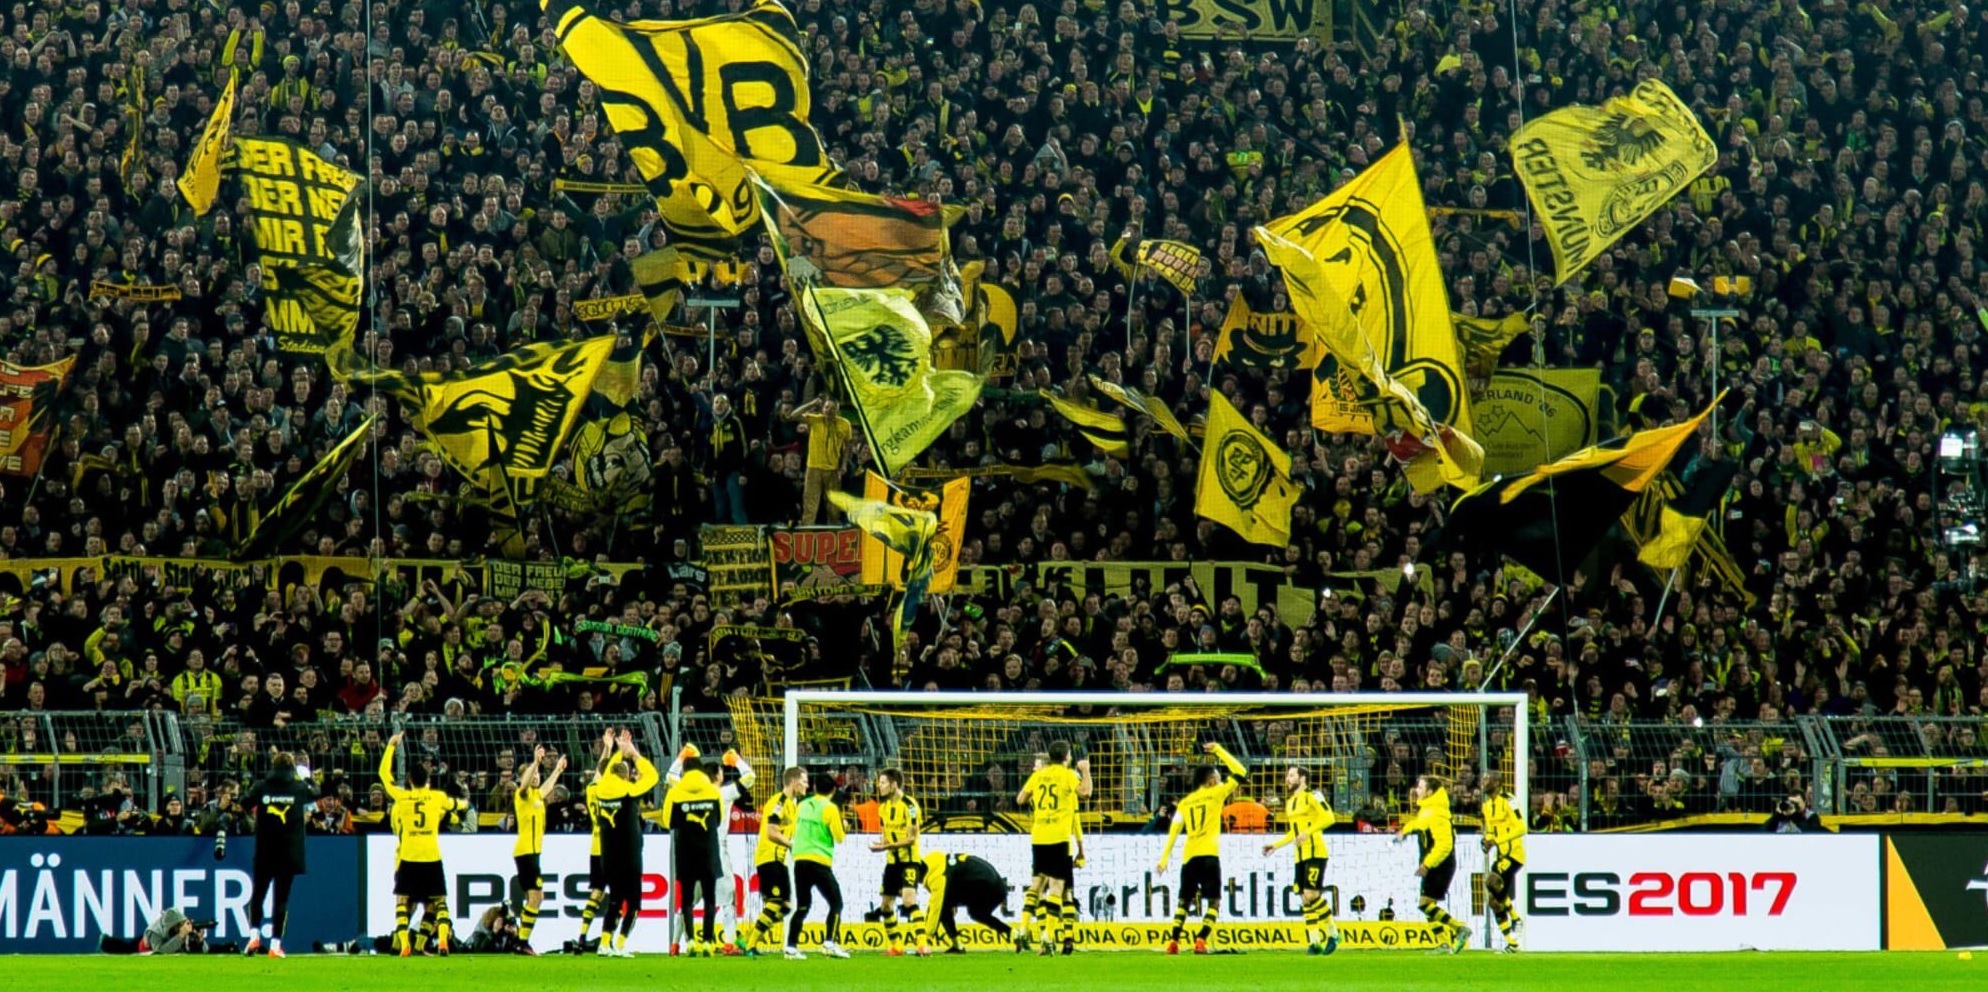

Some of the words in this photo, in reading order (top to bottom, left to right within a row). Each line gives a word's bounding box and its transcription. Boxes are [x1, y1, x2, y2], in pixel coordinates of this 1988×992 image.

[601, 26, 820, 198] BVB
[1482, 389, 1534, 405] RLAND
[773, 529, 863, 565] SUPE
[1038, 784, 1058, 810] 25
[414, 801, 425, 828] 5
[1190, 805, 1205, 831] 17
[958, 928, 1041, 944] SIGNL
[1055, 928, 1117, 944] DUNA
[1146, 929, 1201, 945] PAR
[1216, 928, 1300, 944] SIGNAL
[1305, 928, 1375, 944] INA
[1405, 928, 1459, 944] PAK
